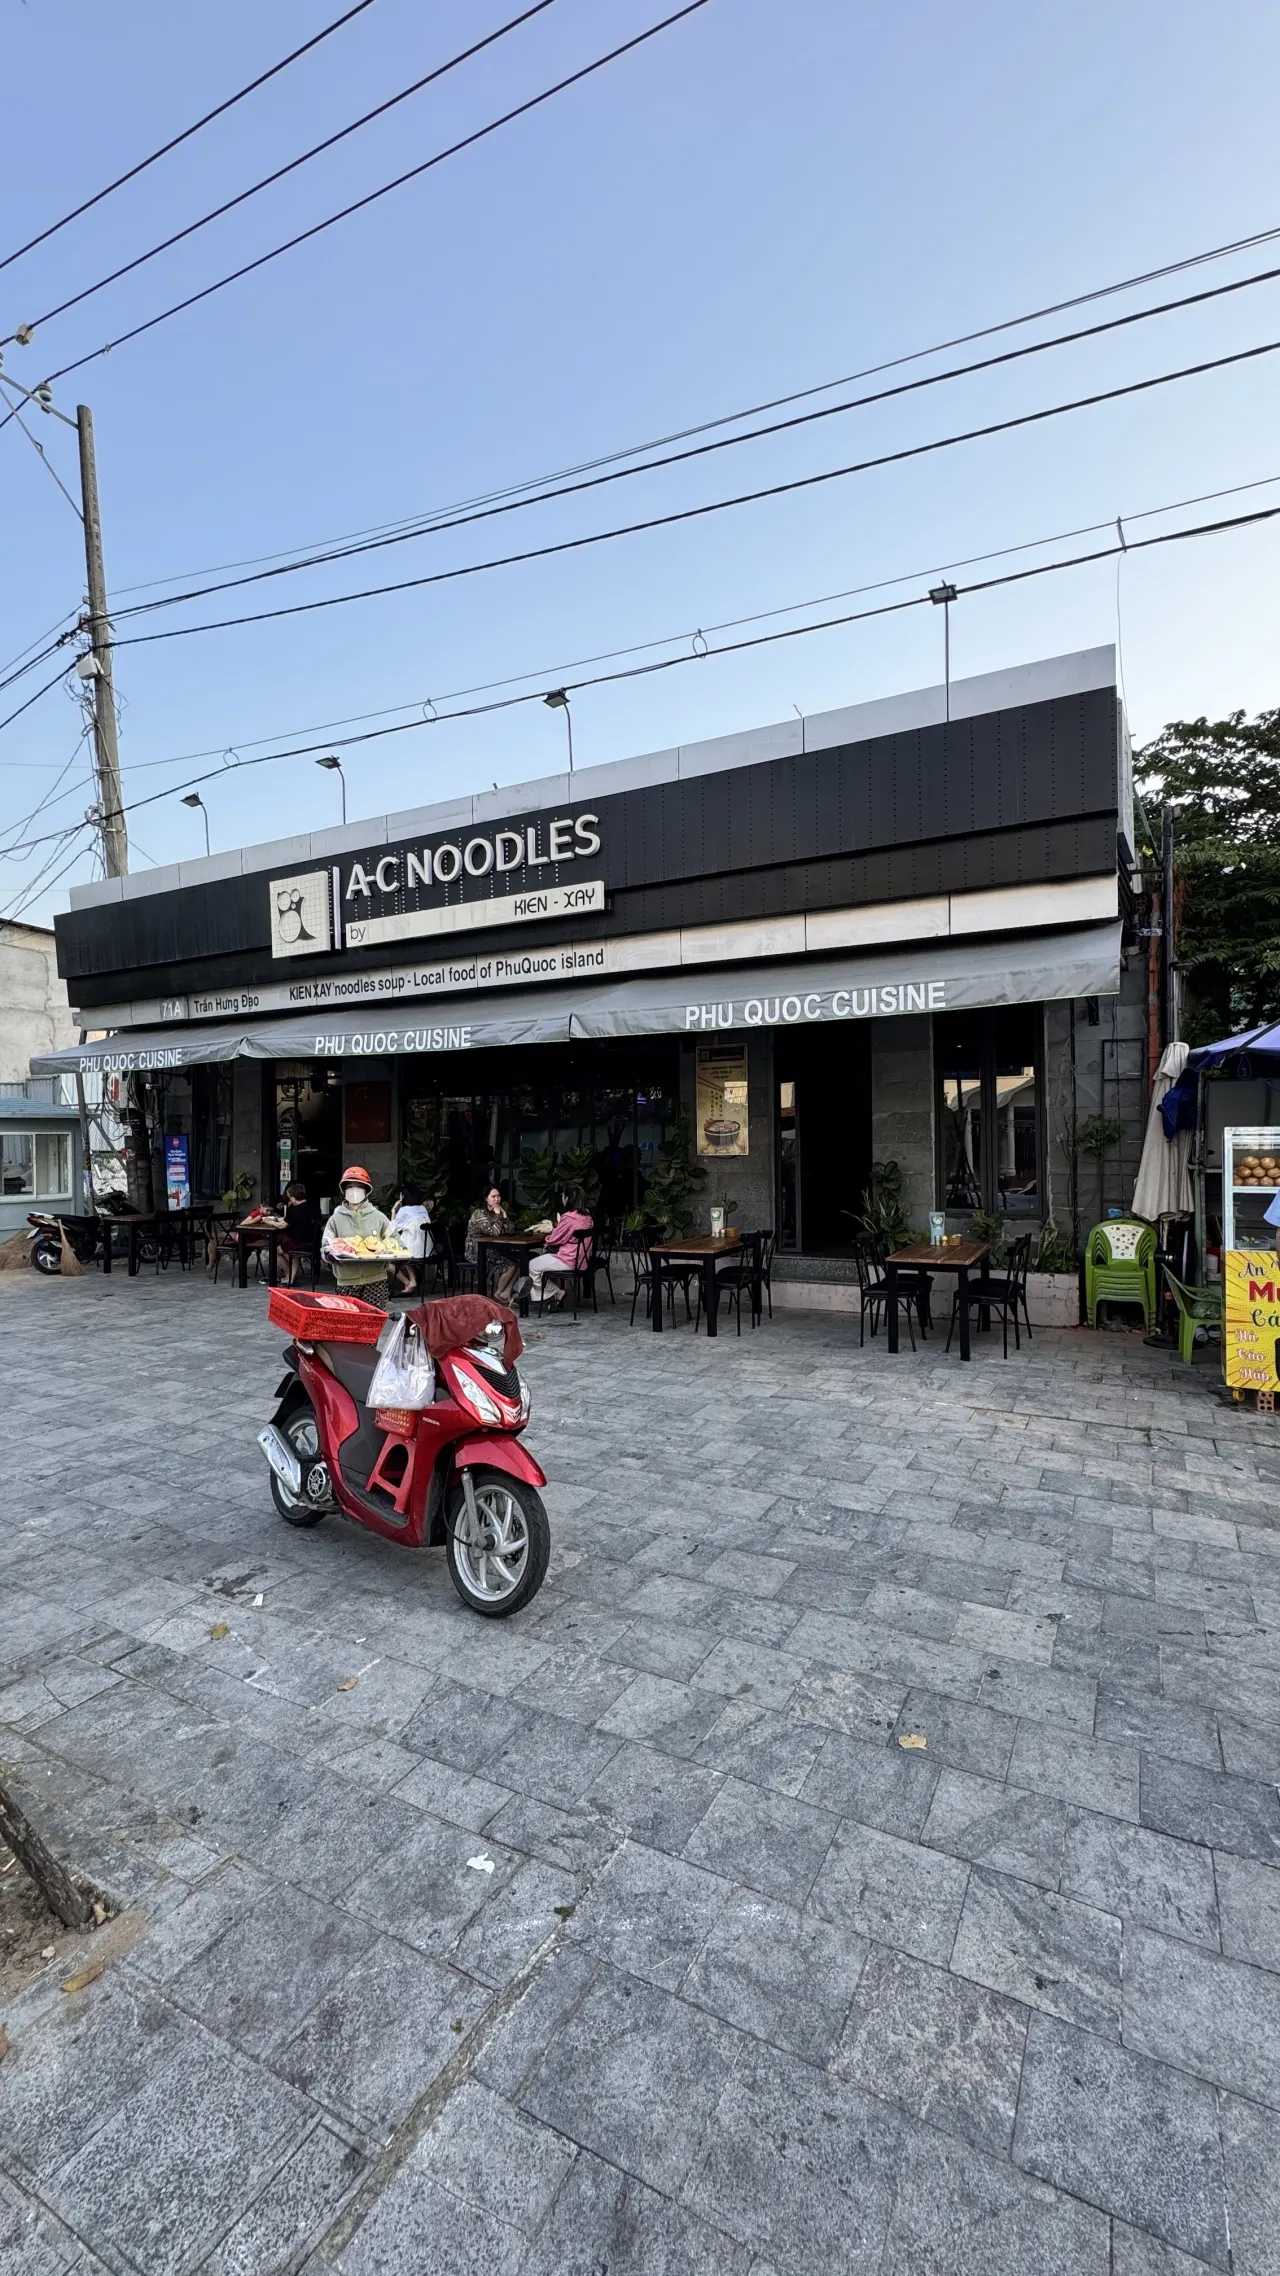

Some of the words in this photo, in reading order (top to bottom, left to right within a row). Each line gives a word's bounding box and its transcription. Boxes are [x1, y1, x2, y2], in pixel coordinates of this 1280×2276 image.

[406, 813, 601, 889] NOODLES
[514, 895, 548, 916] KIEN
[563, 888, 596, 908] XAY
[350, 922, 366, 941] by
[378, 976, 405, 993] soup
[413, 968, 445, 987] Local
[449, 963, 476, 982] food
[480, 961, 492, 979] of
[495, 956, 557, 977] PhuQuoc
[561, 948, 605, 972] island
[161, 1001, 182, 1018] 71A
[685, 1002, 733, 1029] PHU
[744, 993, 821, 1026] QUOC
[832, 981, 946, 1016] CUISINE
[314, 1035, 345, 1055] PHU
[351, 1032, 398, 1053] QUOC
[403, 1026, 472, 1051] CUISINE
[79, 1056, 101, 1073] PHU
[103, 1052, 135, 1071] QUOC
[138, 1049, 182, 1068] CUISINE
